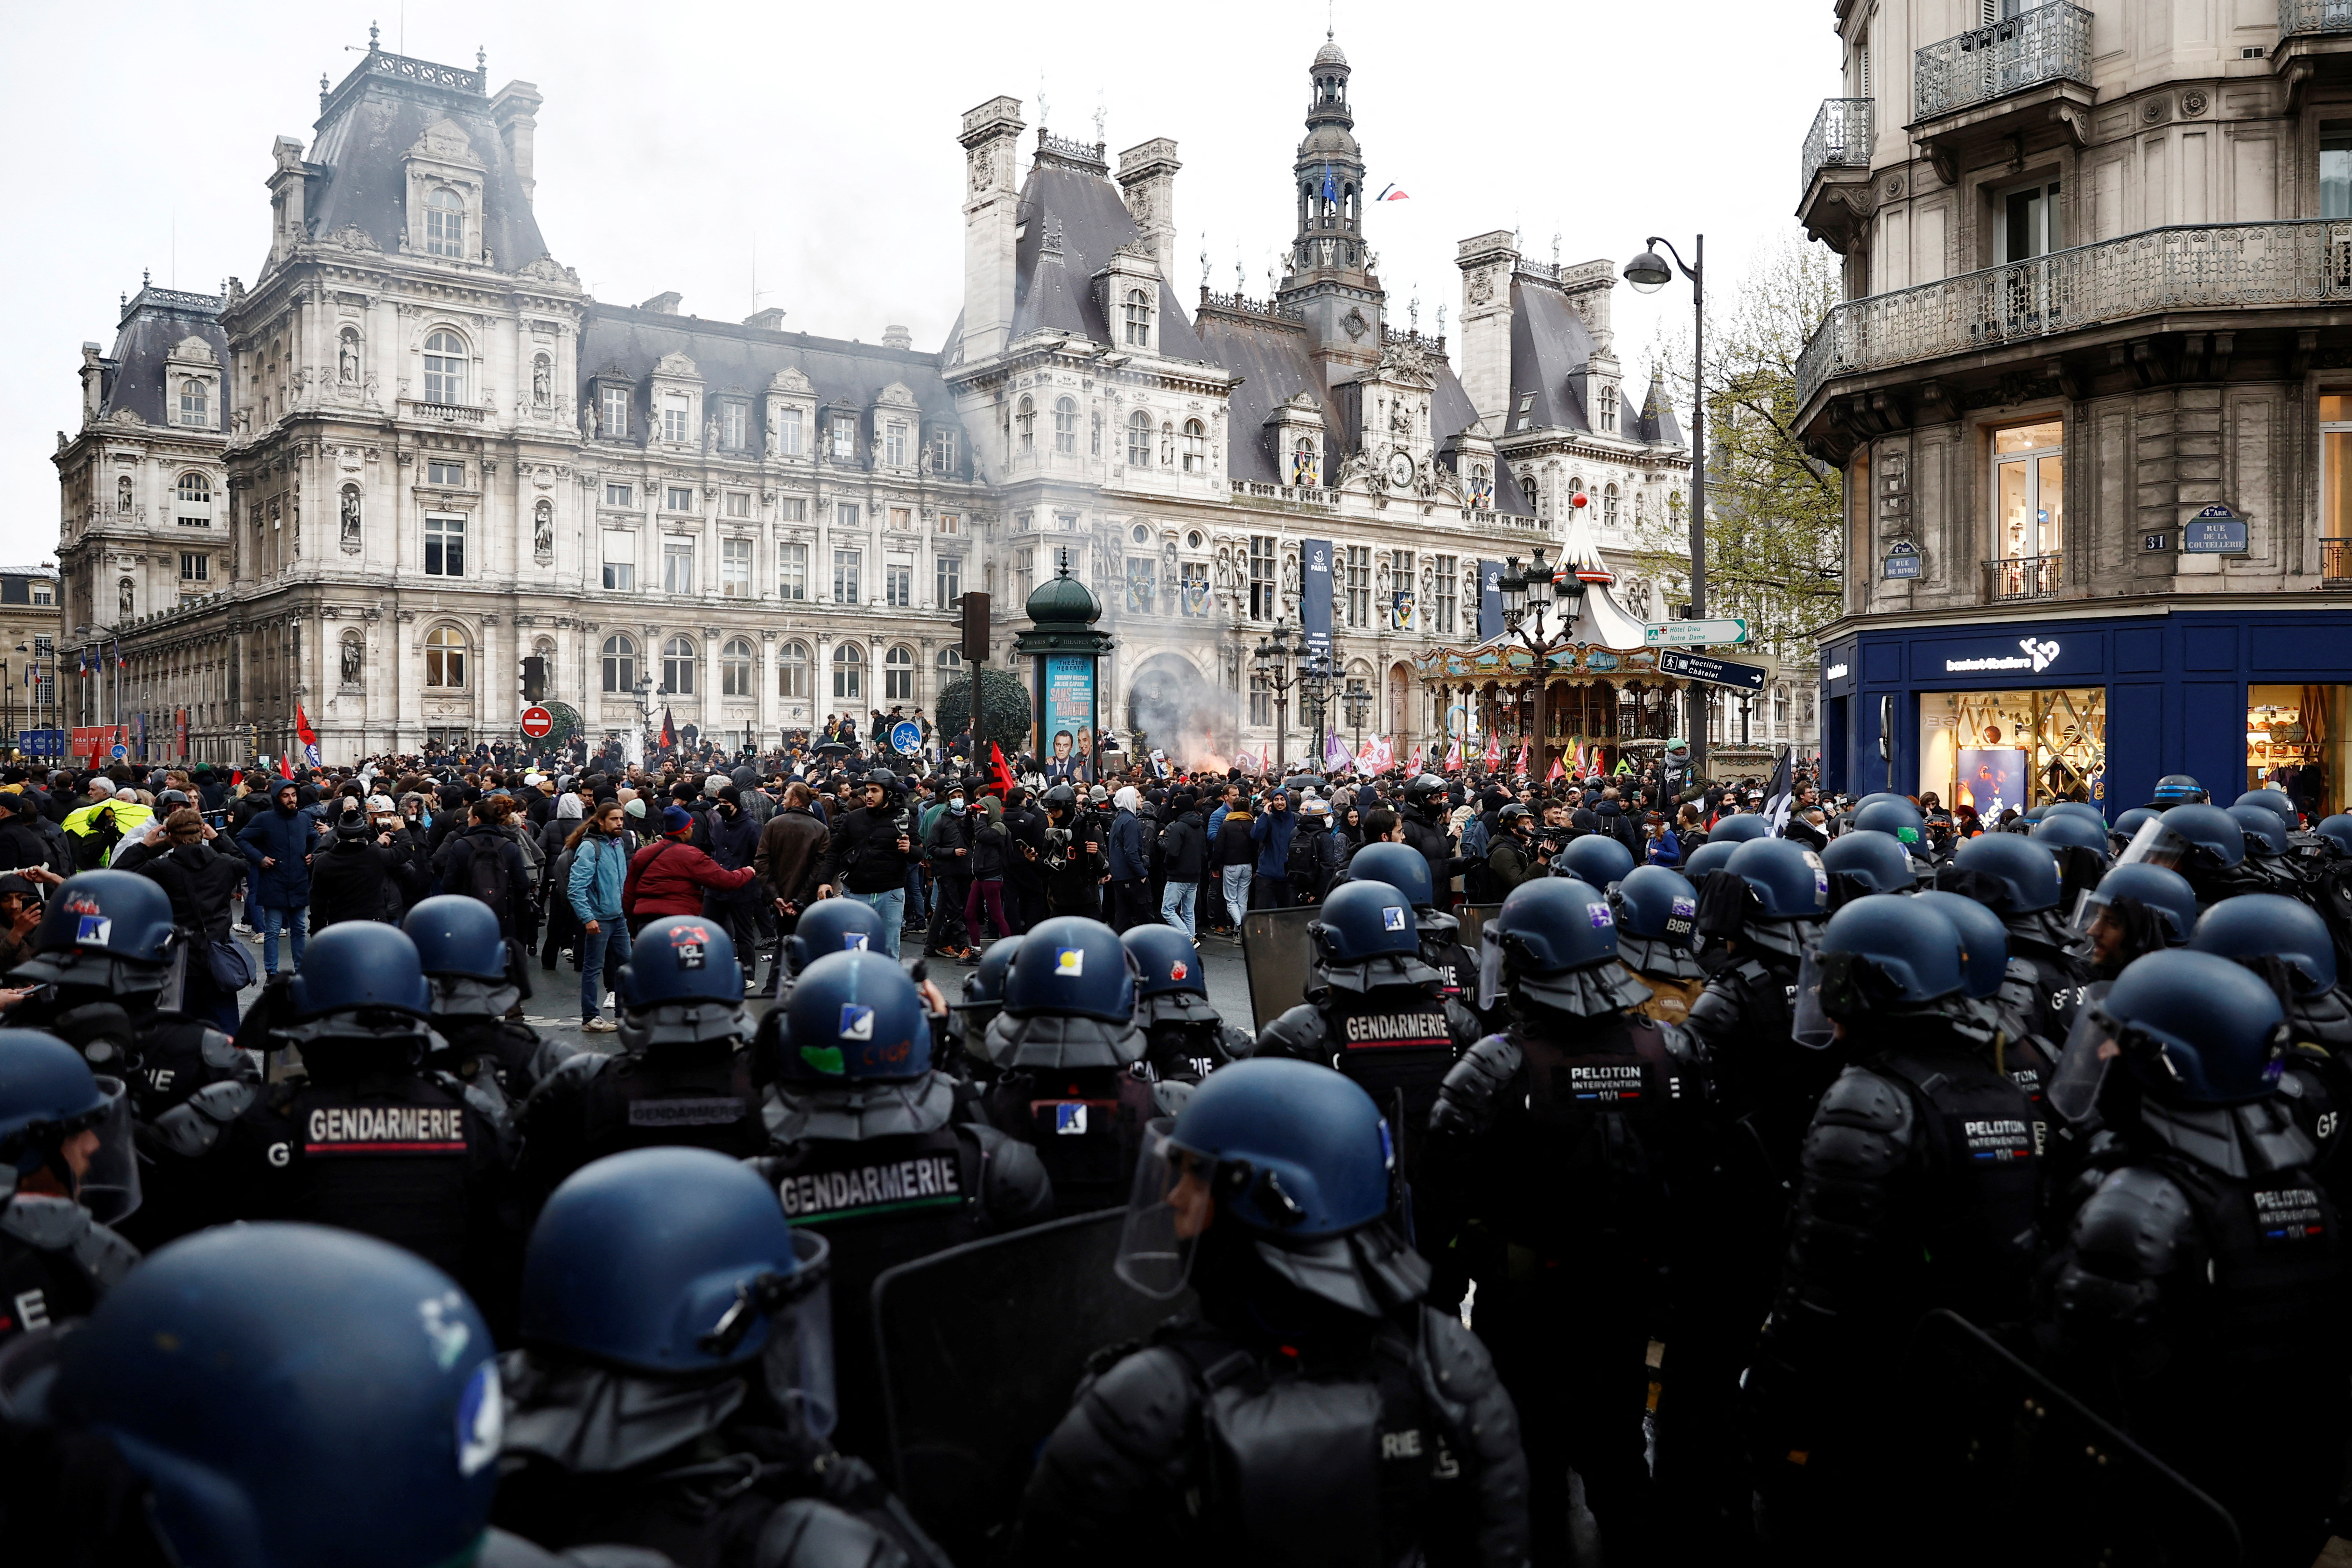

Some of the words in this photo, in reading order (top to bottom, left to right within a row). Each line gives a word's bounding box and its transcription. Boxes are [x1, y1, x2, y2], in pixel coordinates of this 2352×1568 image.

[2147, 535, 2164, 549] 31
[1690, 659, 1722, 671] Noctilien
[1946, 656, 2031, 671] basket4ballers
[1688, 667, 1719, 679] Châtelet
[1050, 688, 1072, 702] SANS
[1056, 702, 1089, 716] RANCUNE
[1667, 918, 1692, 934] BBR
[1346, 1013, 1449, 1041] GENDARMERIE
[1571, 1066, 1641, 1080] PELOTON
[1572, 1080, 1642, 1089] INTERVENTION
[1598, 1090, 1618, 1102] 11/1
[633, 1106, 743, 1121] GENDARMERIE
[310, 1108, 463, 1140] GENDARMERIE
[1965, 1121, 2027, 1136] PELOTON
[1968, 1136, 2029, 1146] INTERVENTION
[1995, 1149, 2014, 1160] 11/1
[780, 1158, 959, 1214] GENDARMERIE
[2254, 1189, 2319, 1210] PELOTON
[2259, 1209, 2321, 1223] INTERVENTION
